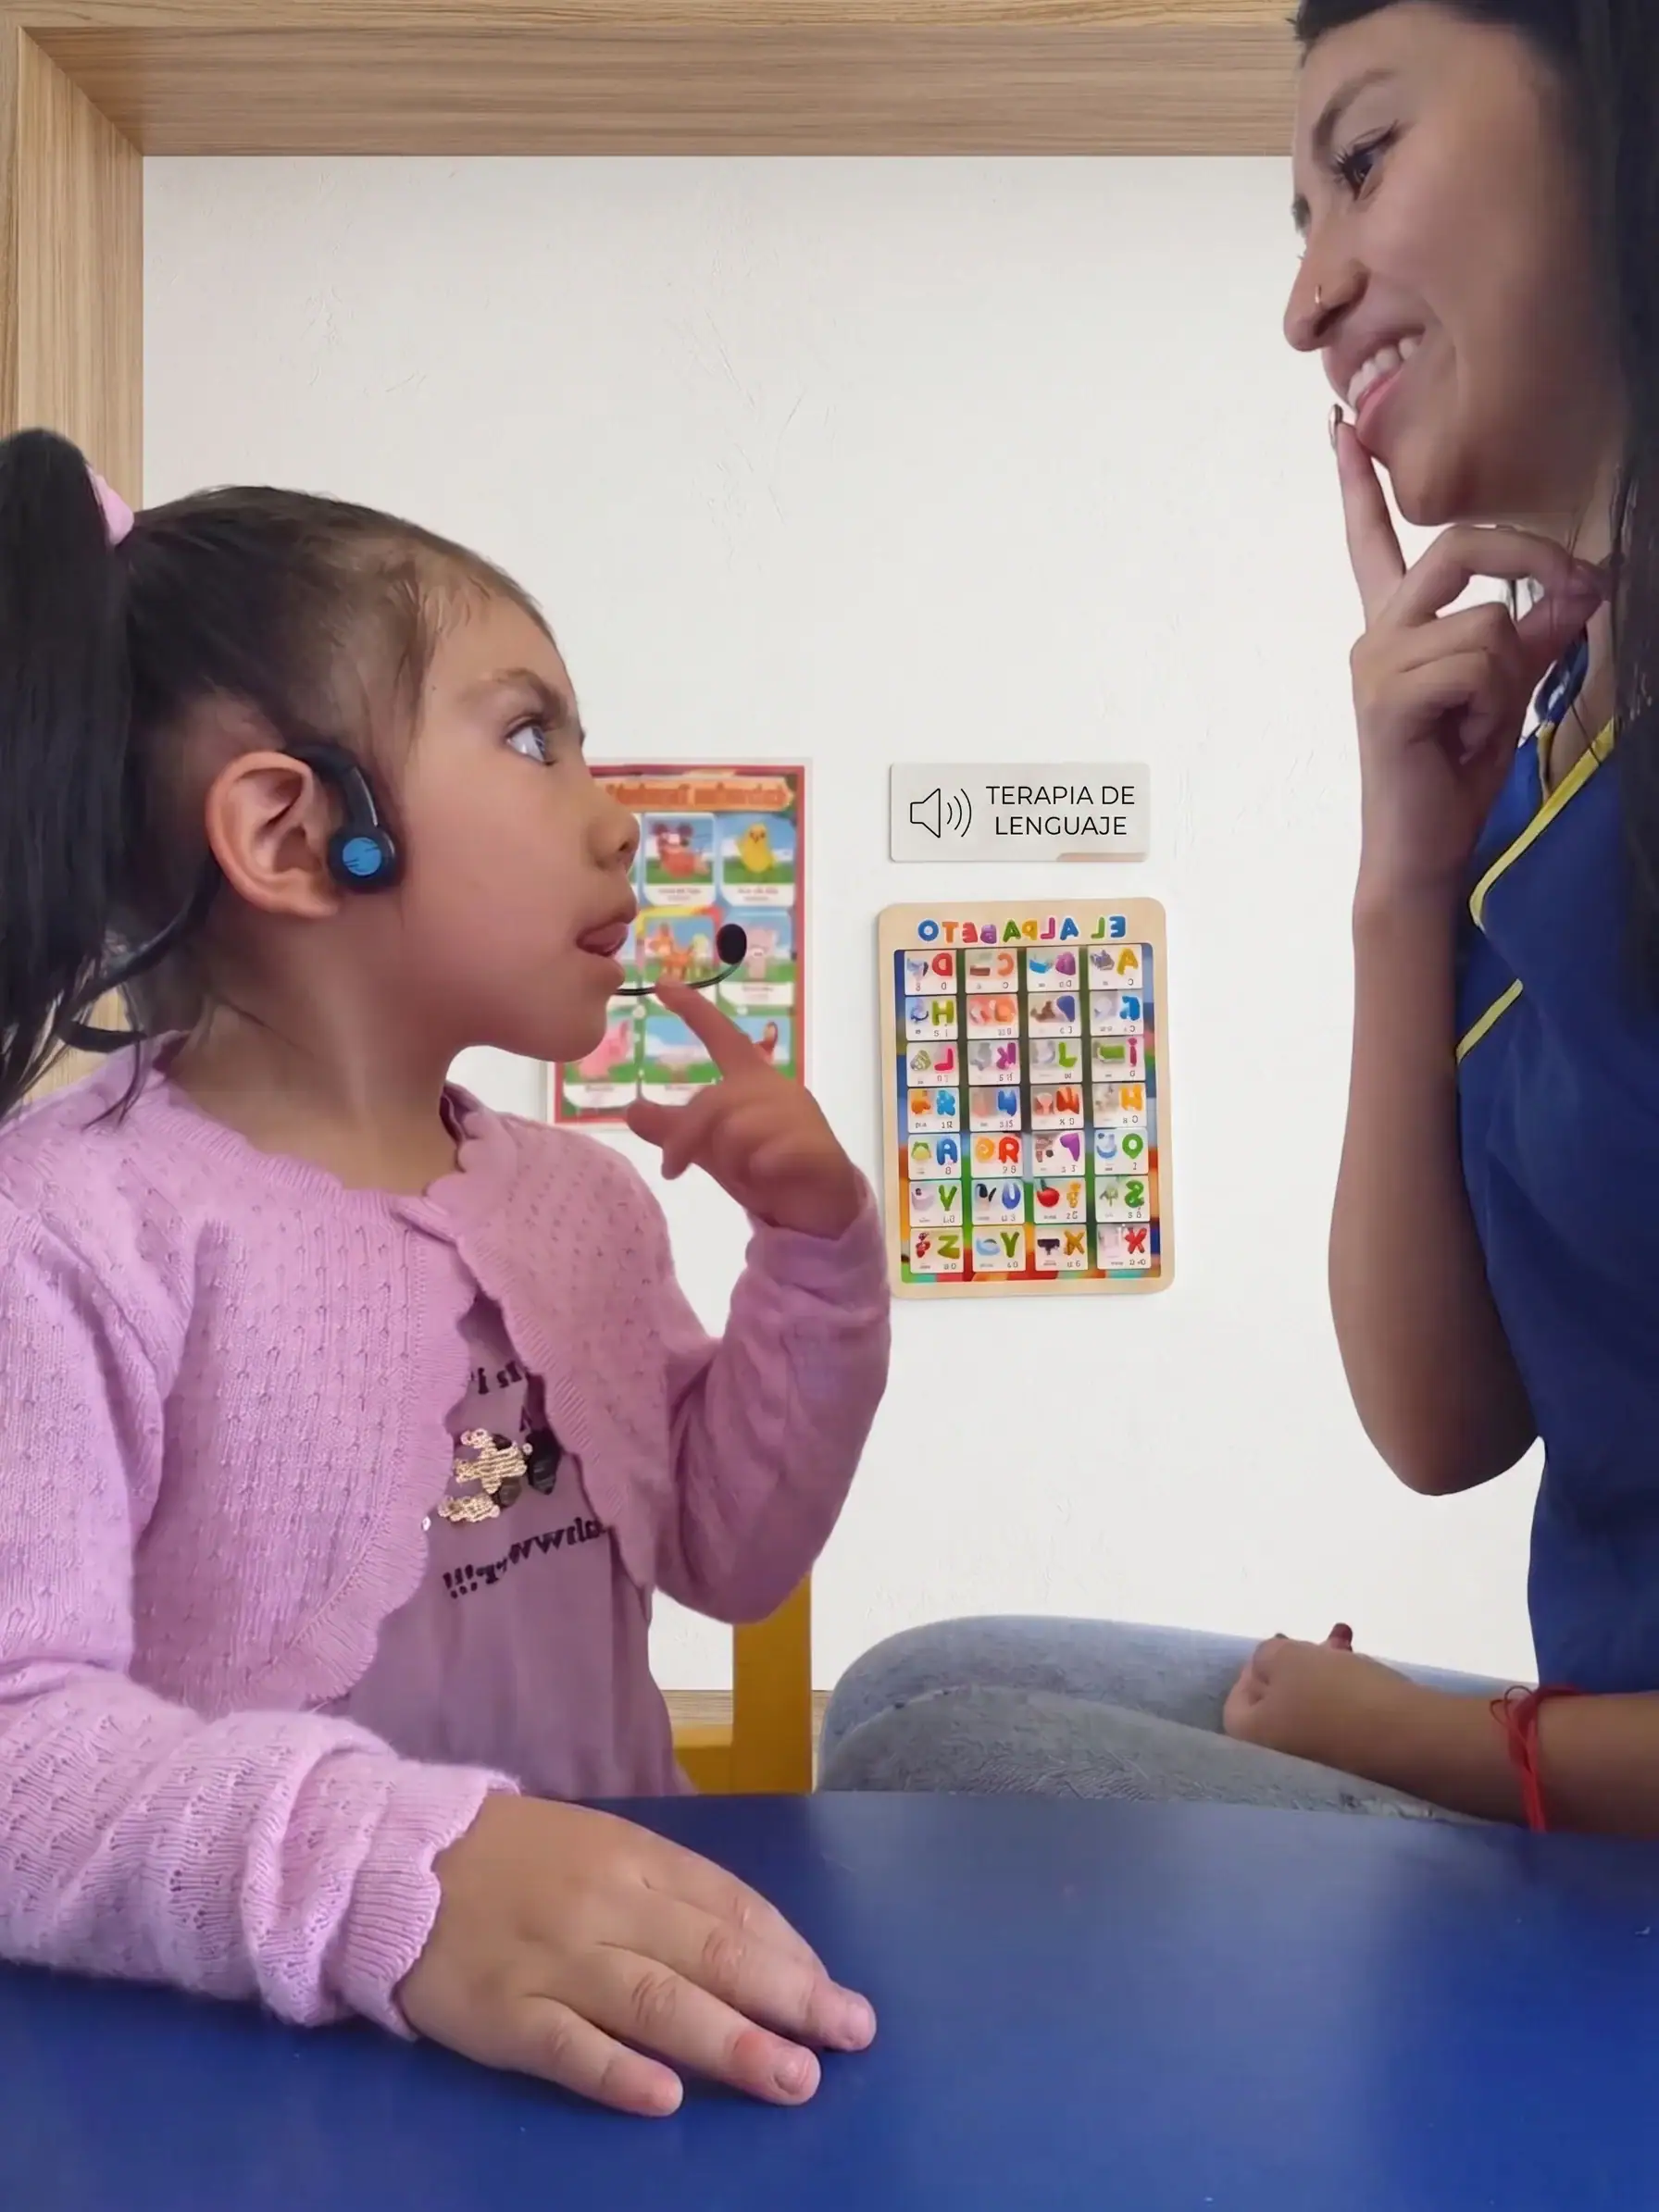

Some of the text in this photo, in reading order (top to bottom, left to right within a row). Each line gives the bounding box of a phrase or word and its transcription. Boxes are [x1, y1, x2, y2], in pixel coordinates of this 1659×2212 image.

[986, 786, 1135, 805] TERAPIA DE
[995, 816, 1127, 836] LENGUAJE
